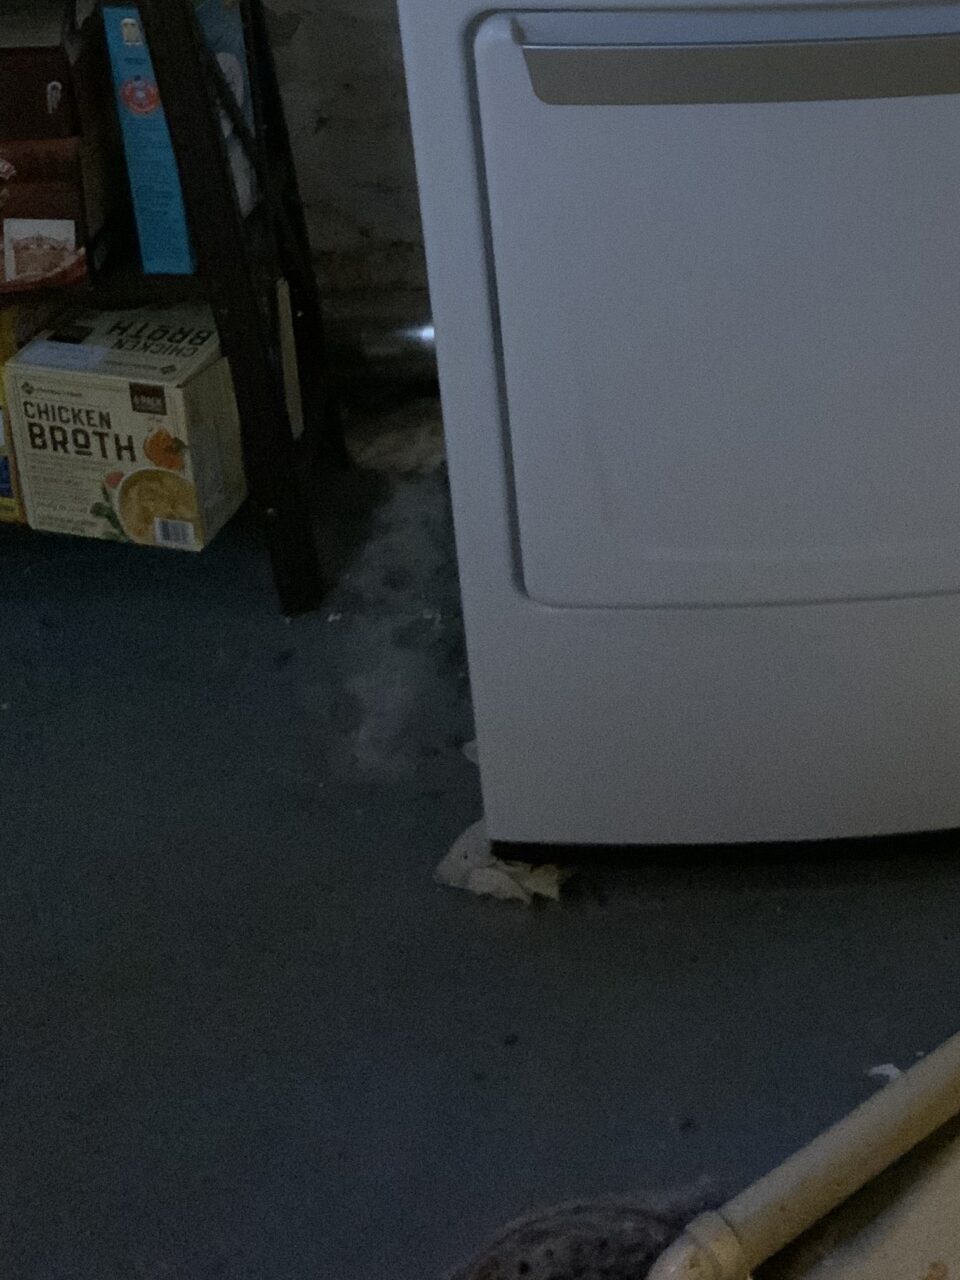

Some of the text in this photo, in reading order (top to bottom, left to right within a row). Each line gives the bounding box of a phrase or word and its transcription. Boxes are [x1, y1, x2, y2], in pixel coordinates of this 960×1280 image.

[108, 321, 212, 345] BROTH
[111, 339, 198, 358] CHICKEN
[22, 400, 112, 430] CHICKEN
[27, 422, 137, 462] BROTH
